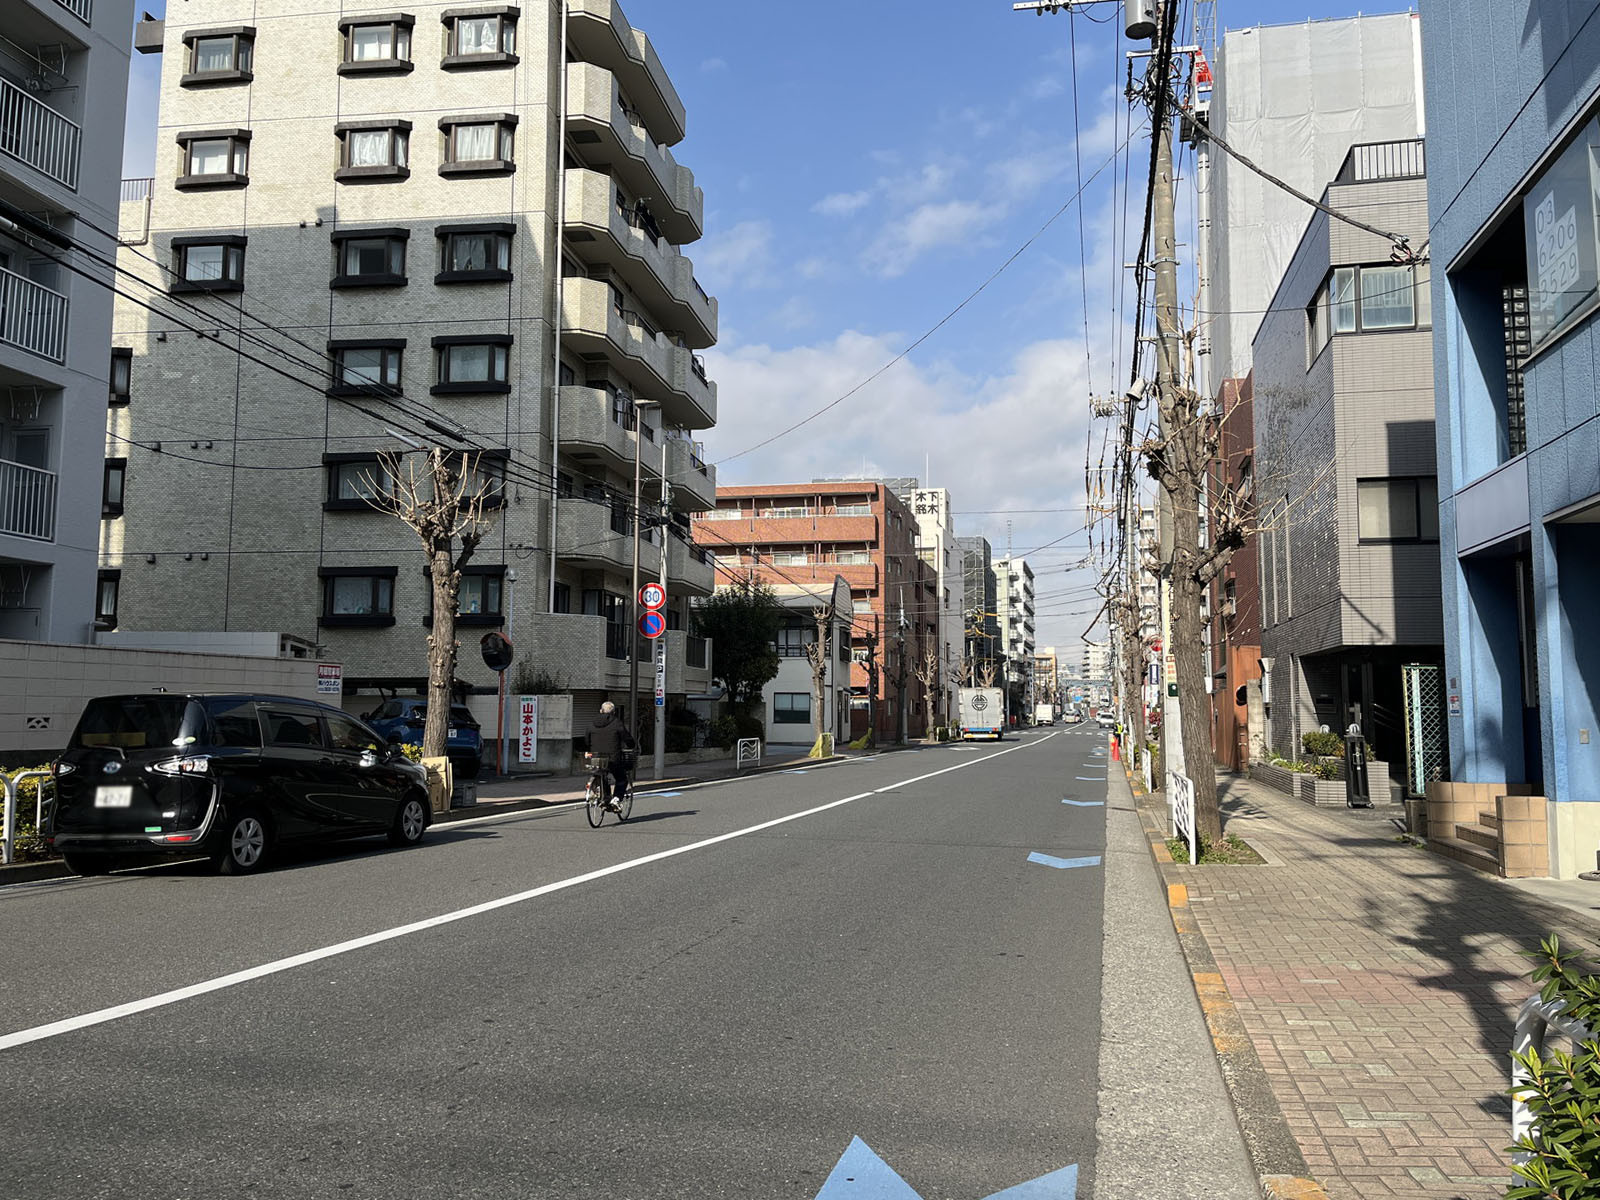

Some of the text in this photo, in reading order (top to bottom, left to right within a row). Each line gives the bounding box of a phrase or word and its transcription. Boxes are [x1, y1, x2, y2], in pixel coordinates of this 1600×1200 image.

[1536, 200, 1554, 234] 03
[1539, 215, 1576, 268] 6206
[915, 491, 938, 502] 木下
[644, 590, 660, 603] 30
[522, 702, 534, 757] 山本かよこ
